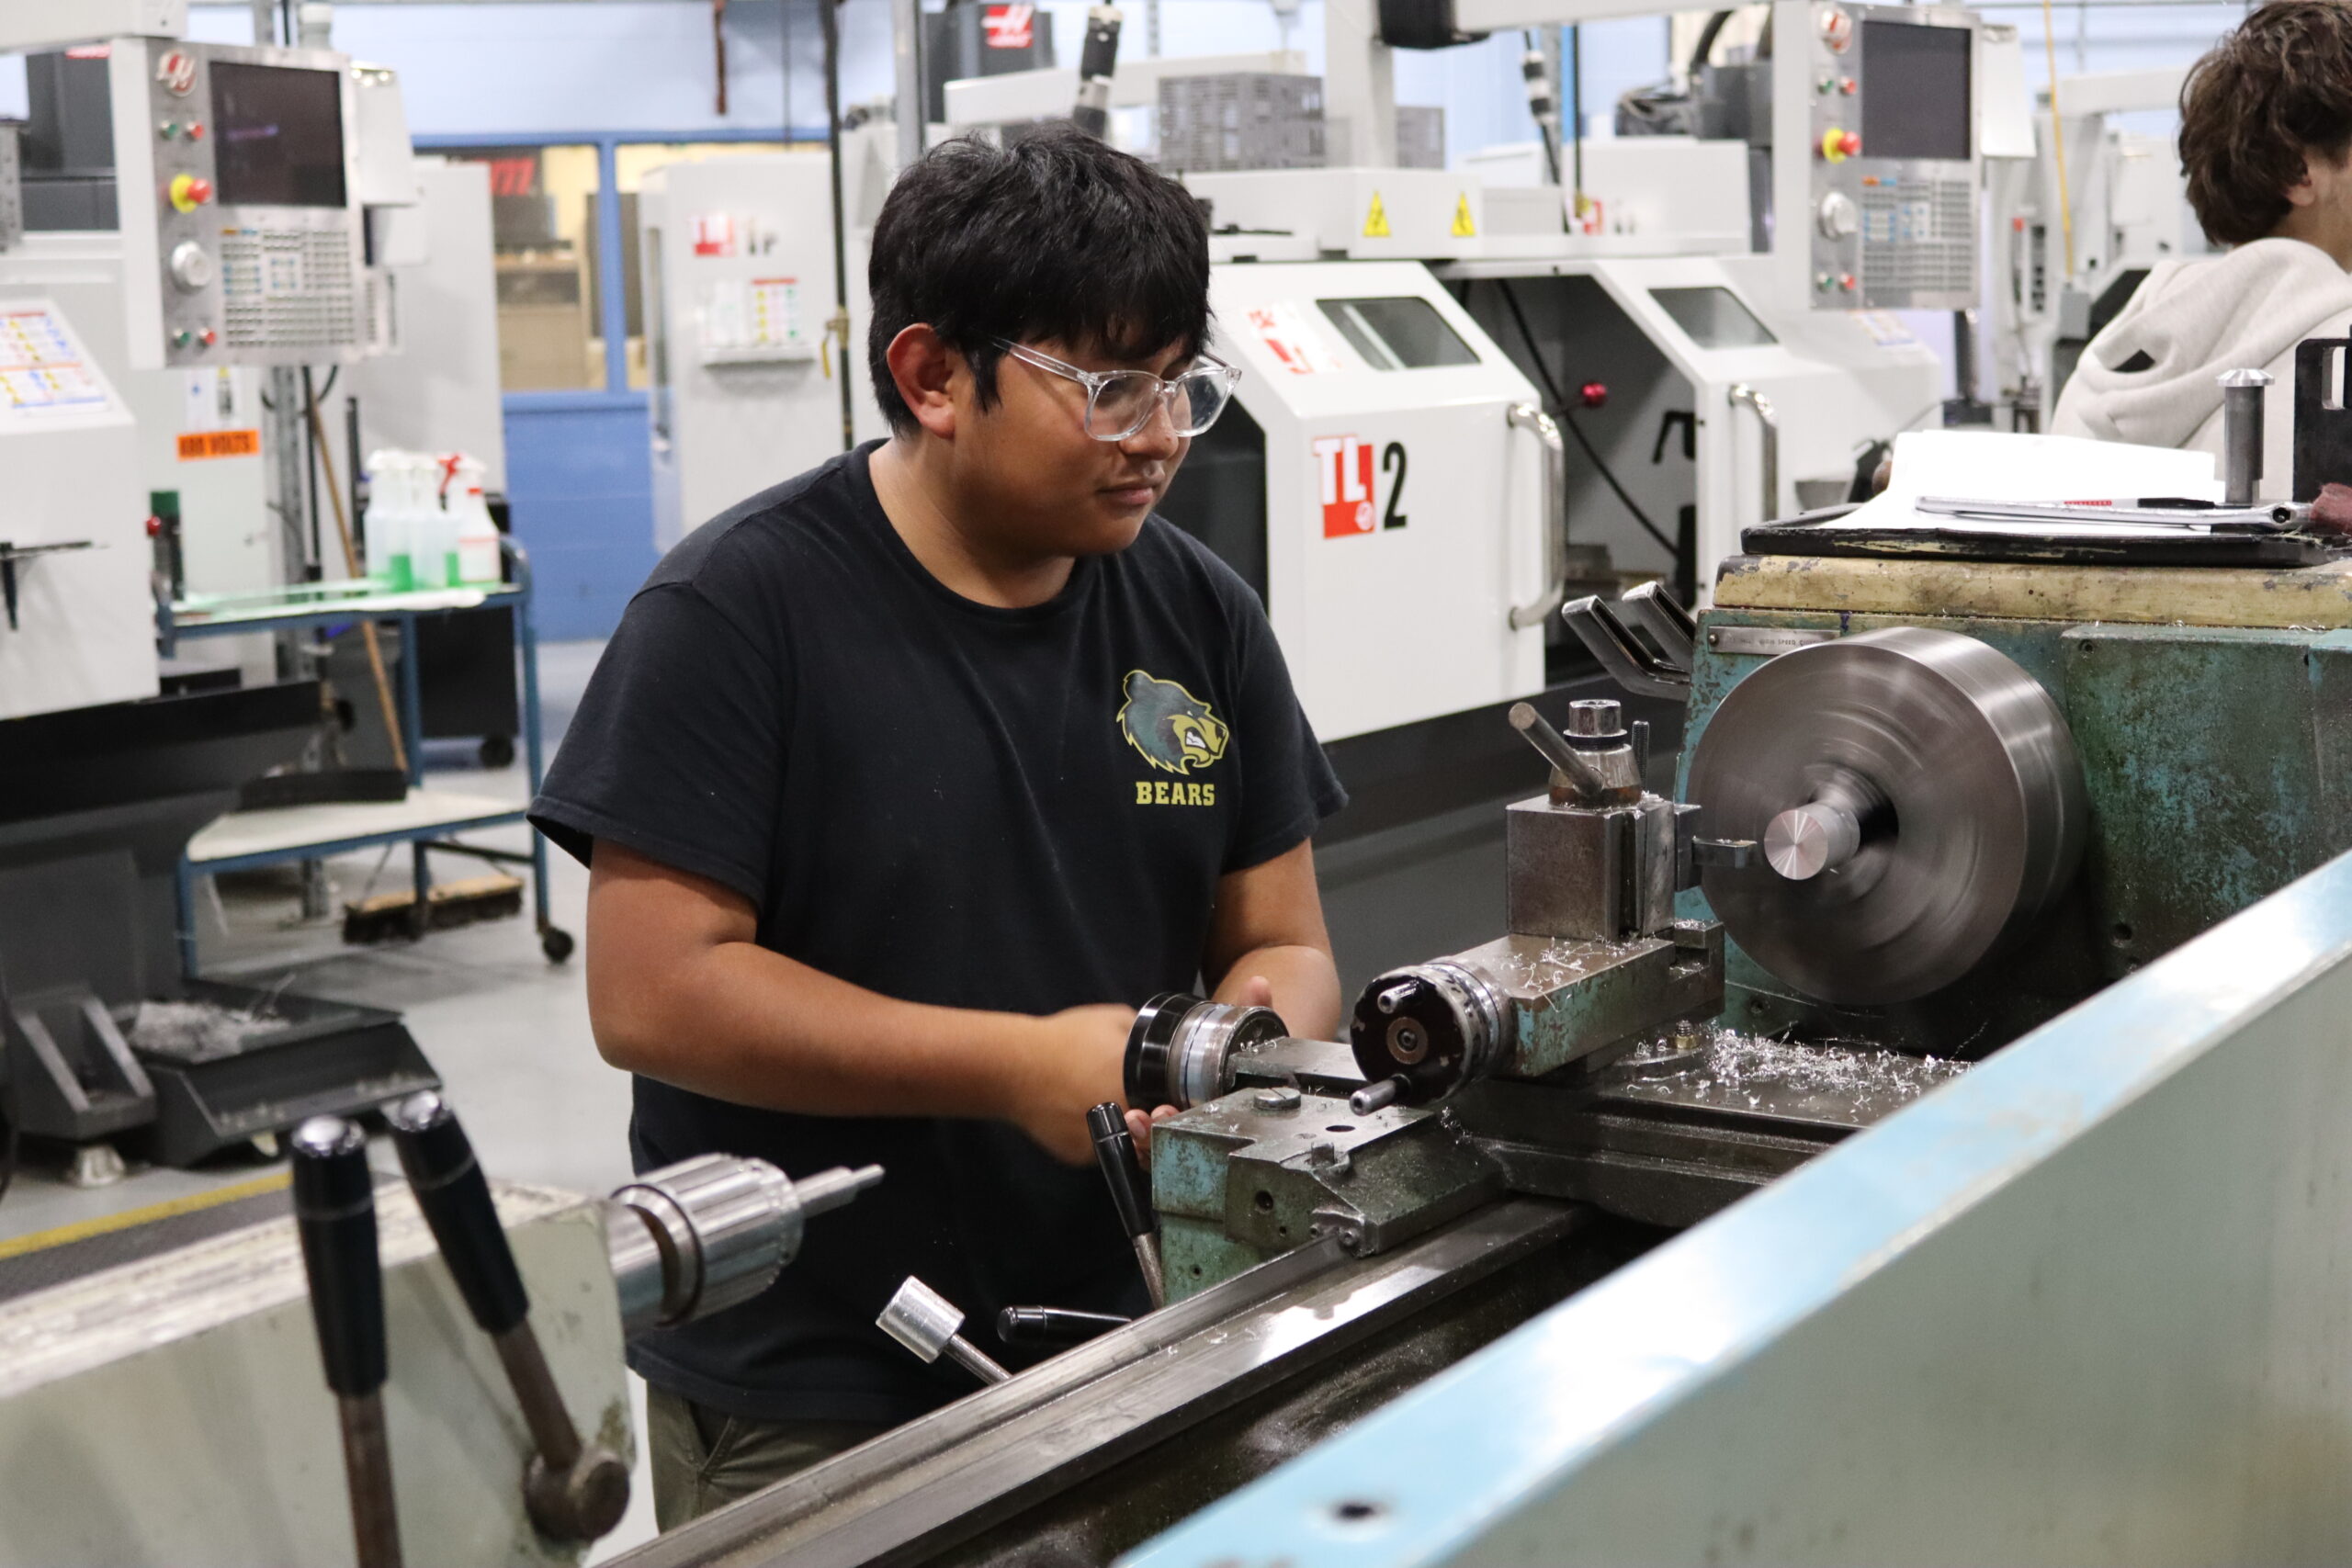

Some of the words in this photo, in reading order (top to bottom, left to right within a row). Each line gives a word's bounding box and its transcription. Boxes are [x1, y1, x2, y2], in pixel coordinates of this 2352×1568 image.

[1312, 435, 1367, 505] TL
[1382, 440, 1407, 530] 2
[1136, 782, 1215, 806] BEARS
